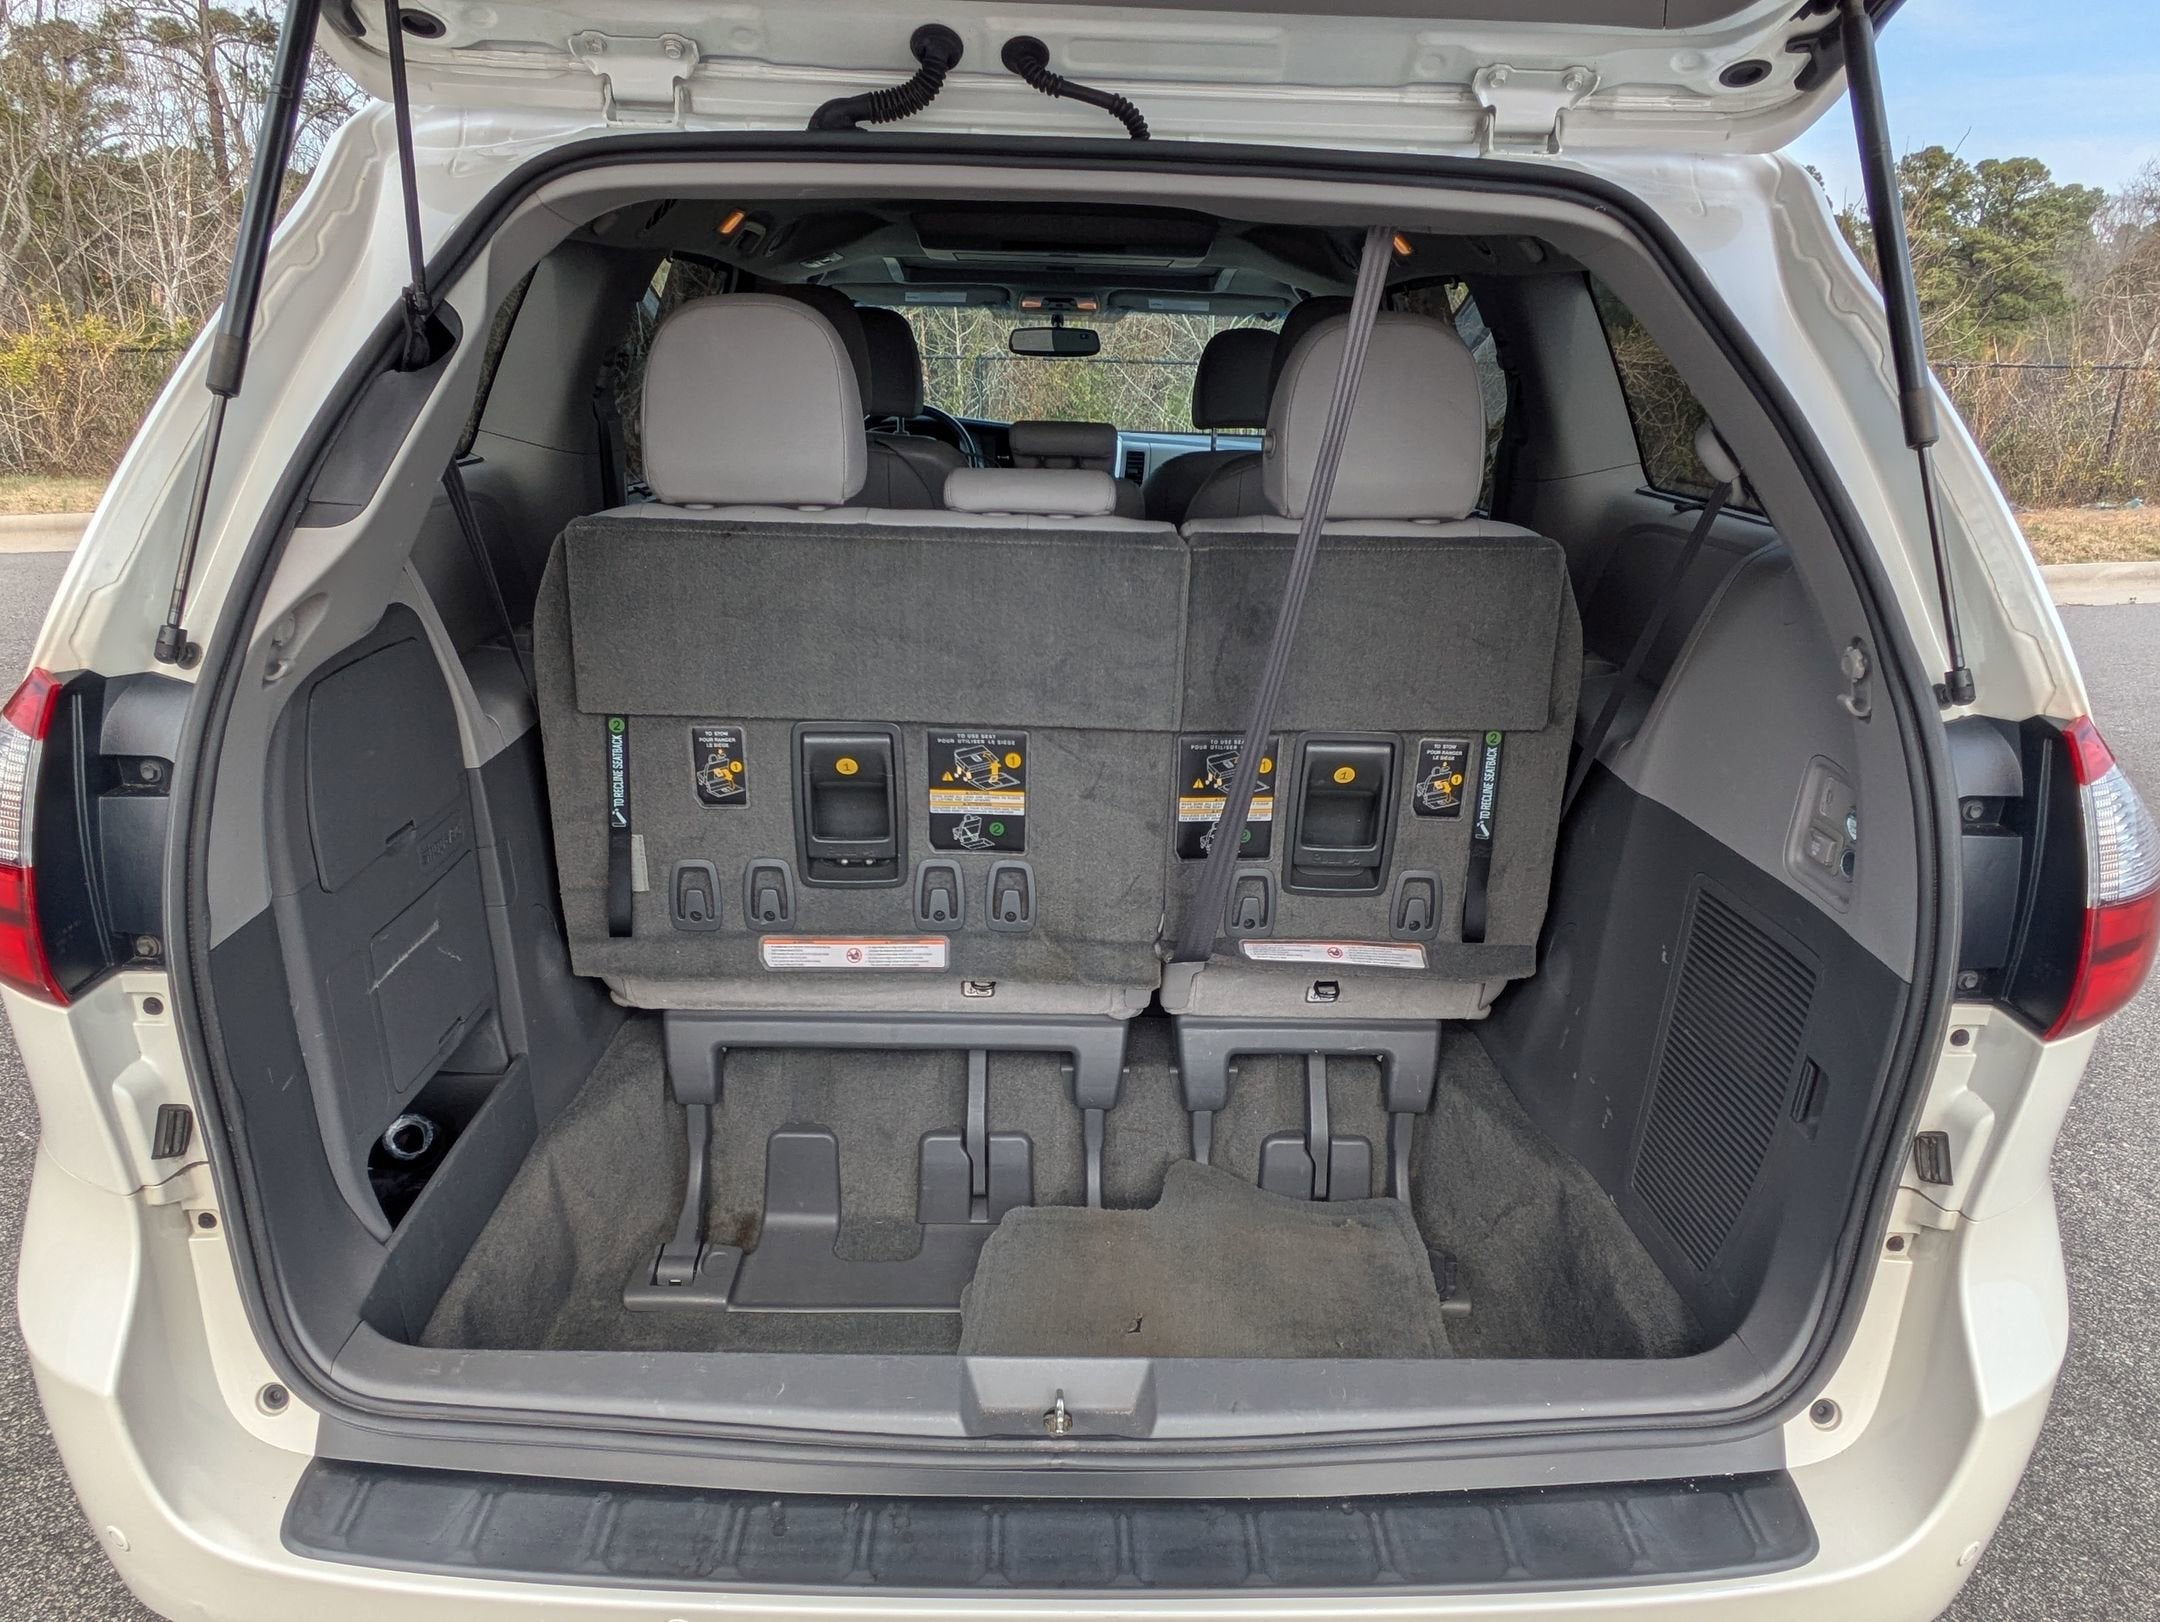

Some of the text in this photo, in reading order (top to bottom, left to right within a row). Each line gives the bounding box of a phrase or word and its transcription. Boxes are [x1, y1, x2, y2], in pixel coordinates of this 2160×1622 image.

[611, 734, 625, 808] TO RECLINE SEATBACK
[1479, 746, 1498, 820] TO RECLINE SEATBACK
